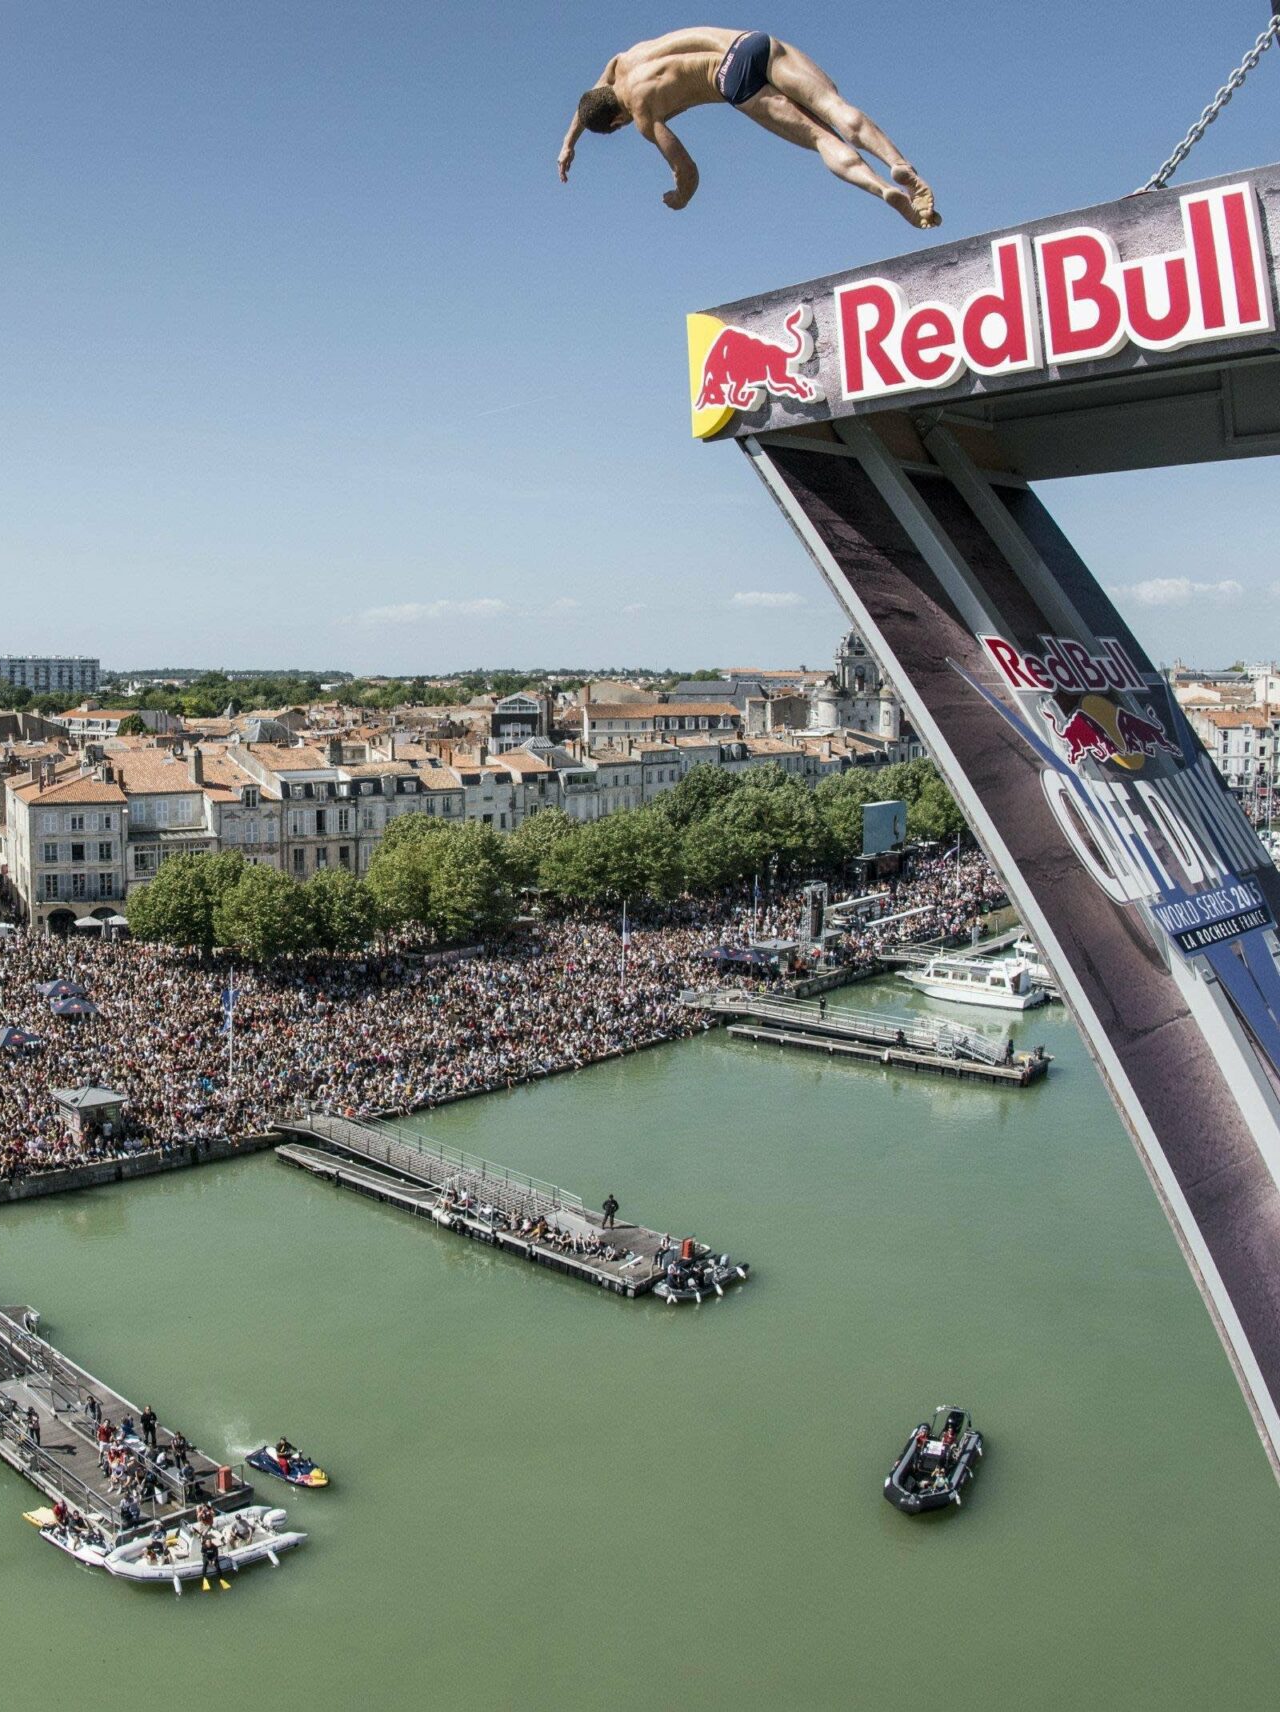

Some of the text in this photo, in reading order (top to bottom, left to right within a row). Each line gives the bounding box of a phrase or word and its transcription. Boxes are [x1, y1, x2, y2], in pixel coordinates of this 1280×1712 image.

[838, 189, 1263, 396] Red Bull
[984, 637, 1146, 690] Red Bull
[1155, 881, 1263, 932] WORLD SERIES 2015
[1181, 910, 1267, 950] LA ROCHELLE FRANCE
